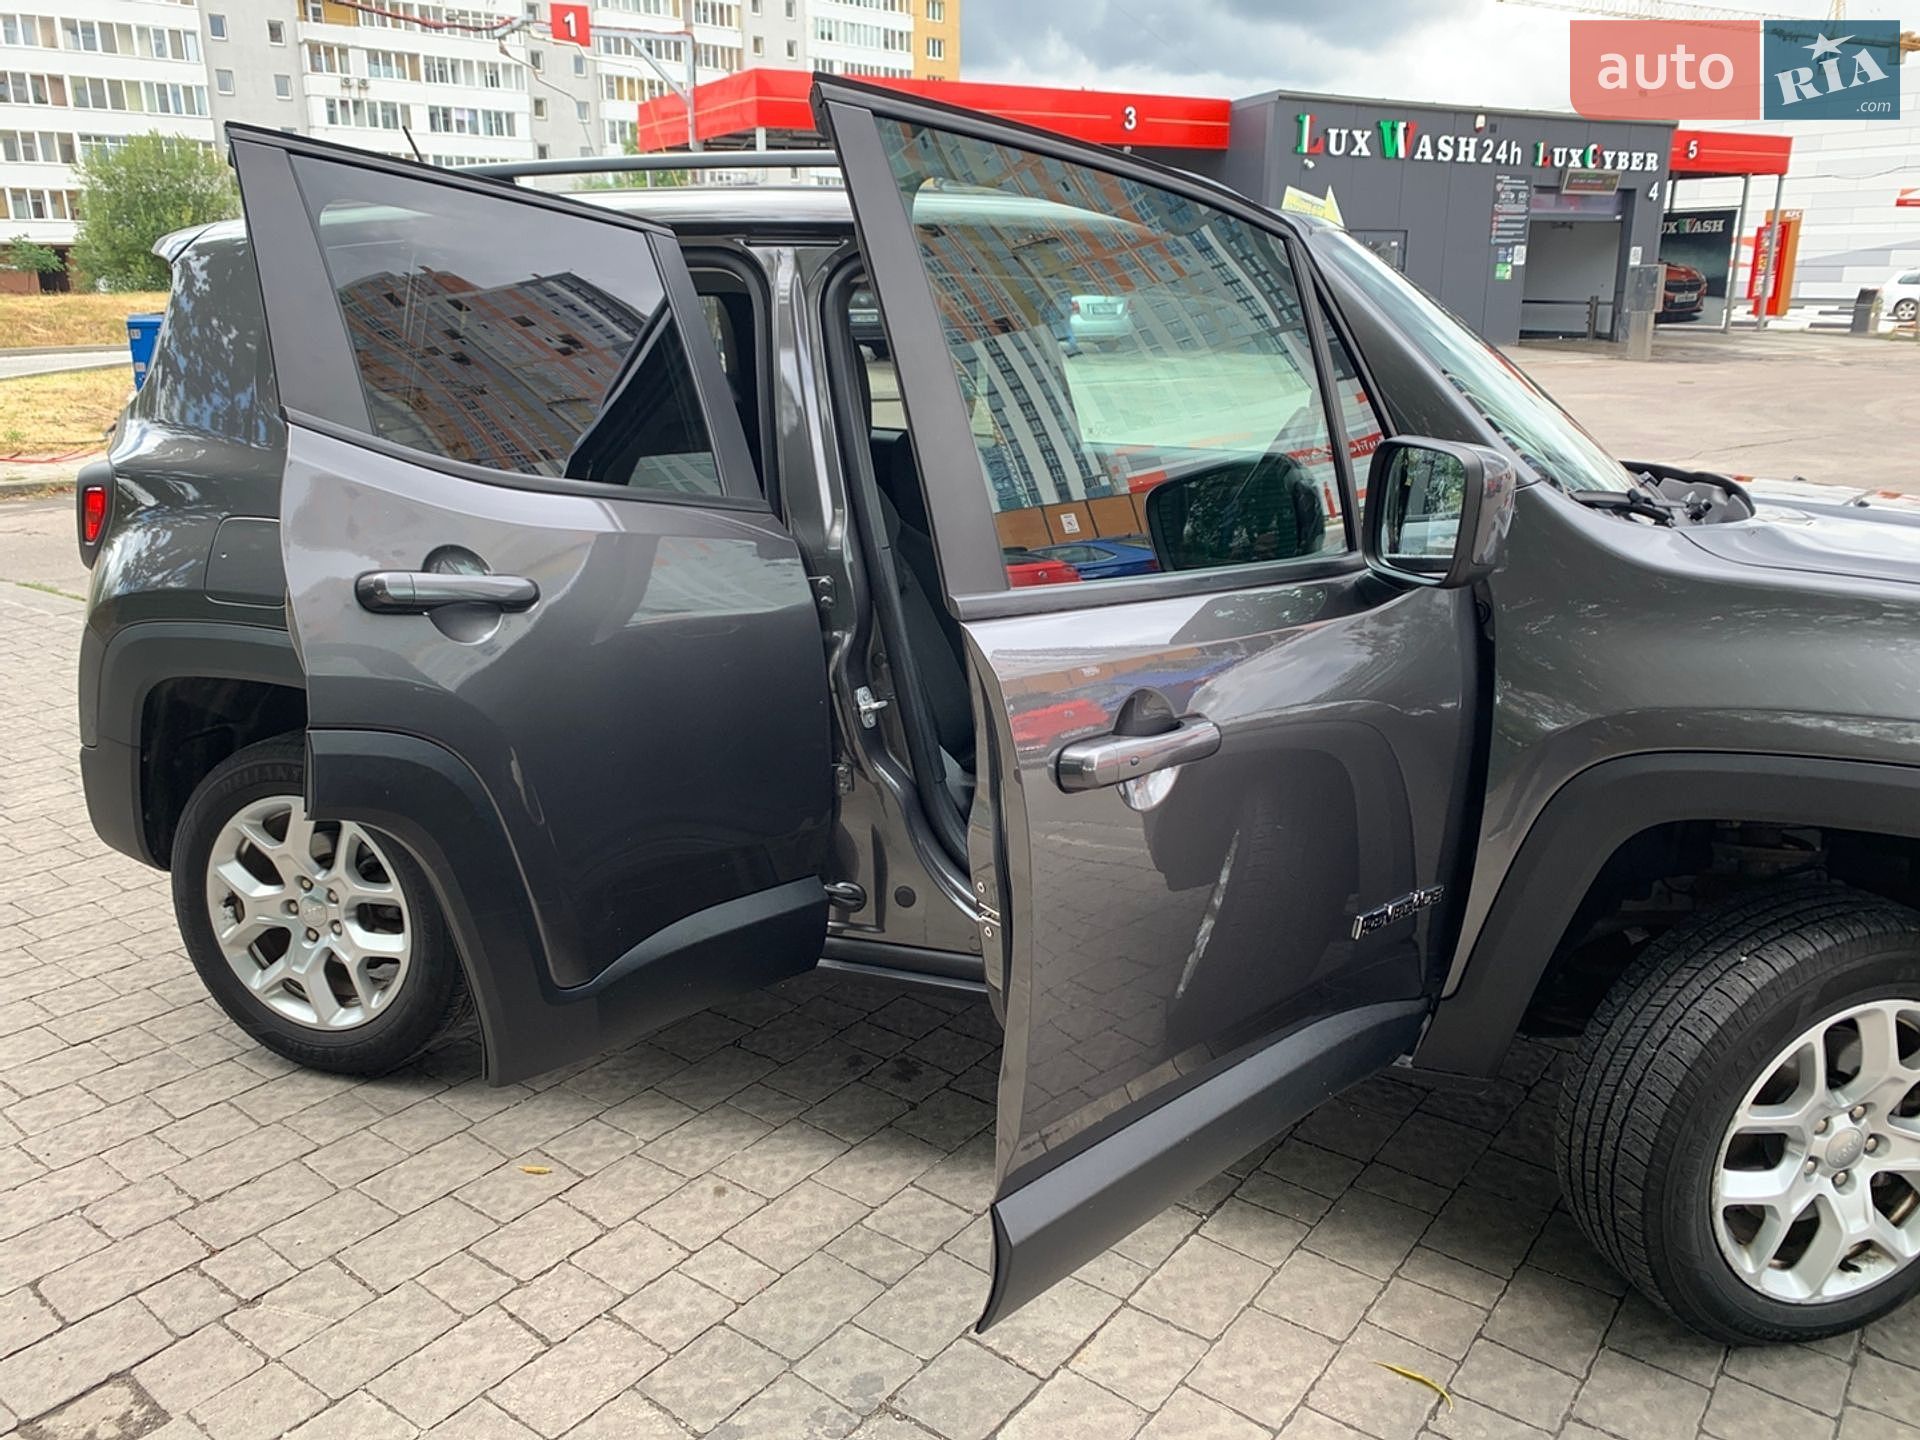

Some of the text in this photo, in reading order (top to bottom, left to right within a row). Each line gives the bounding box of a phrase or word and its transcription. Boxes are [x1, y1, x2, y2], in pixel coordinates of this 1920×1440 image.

[564, 11, 577, 38] 1
[1124, 106, 1137, 130] 3
[1297, 114, 1522, 165] LUX WASH 24h
[1687, 140, 1699, 160] 5
[1648, 181, 1660, 201] 4
[1679, 217, 1726, 234] WASH
